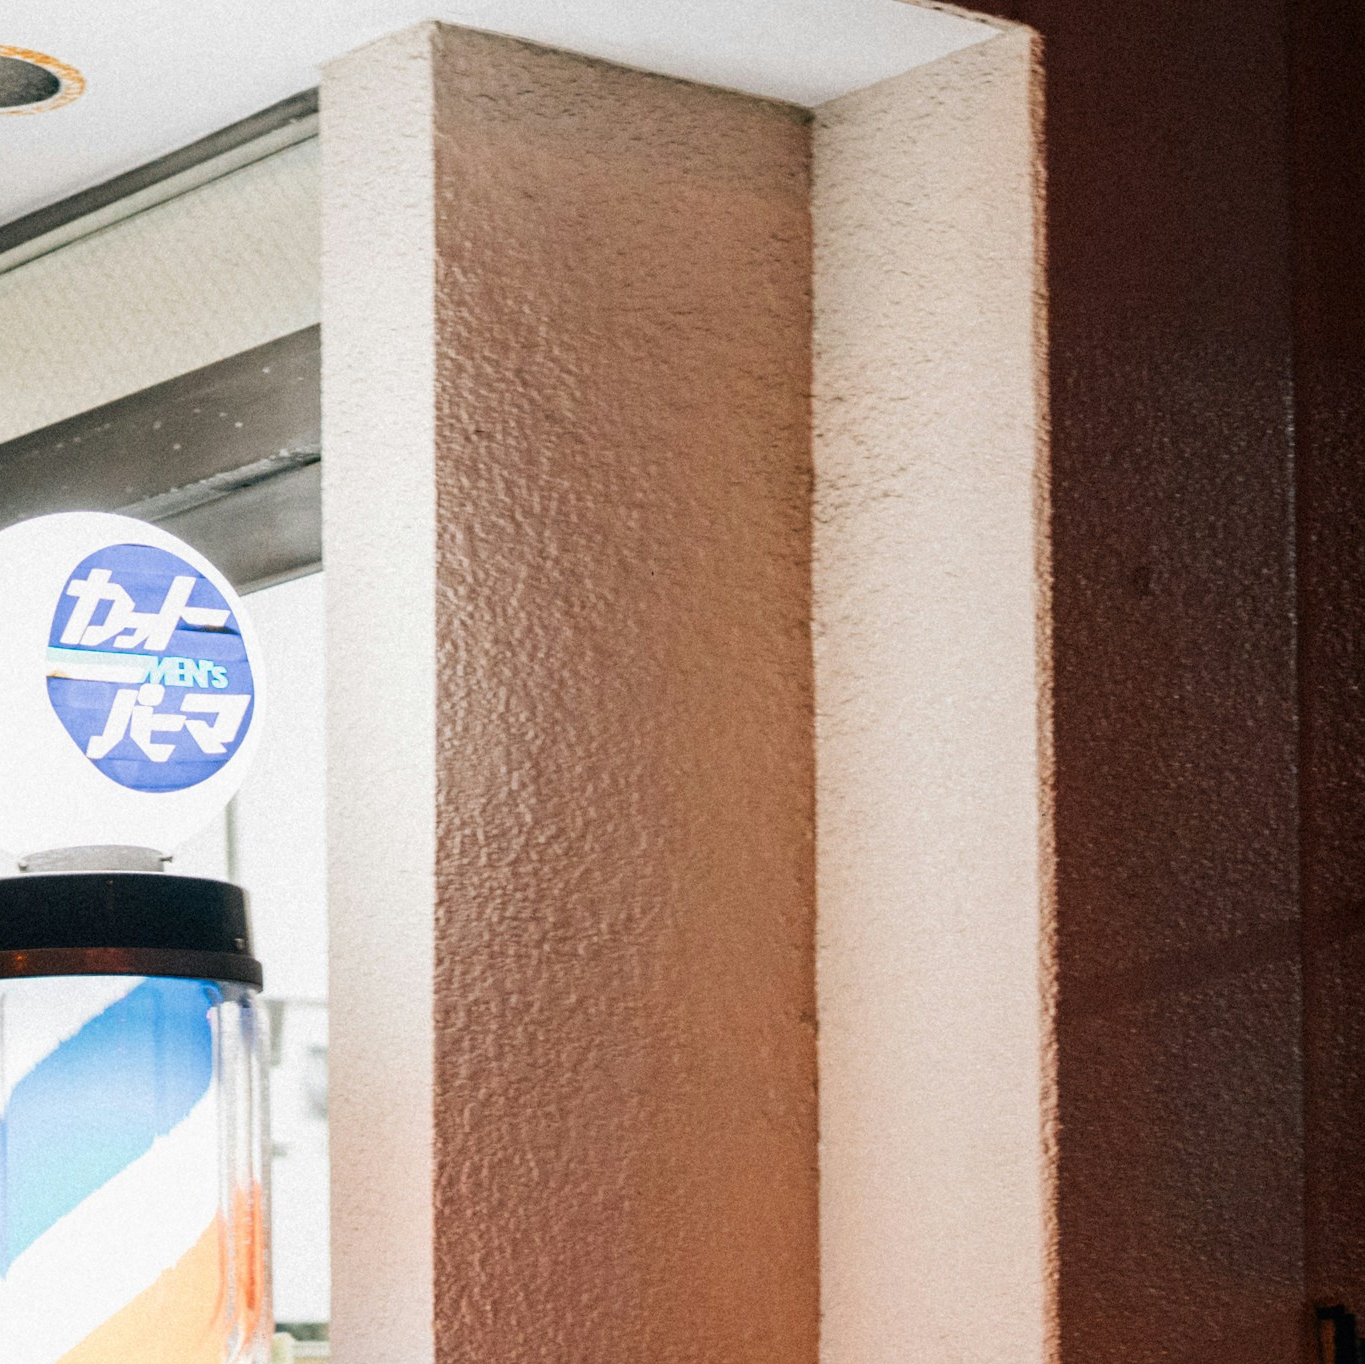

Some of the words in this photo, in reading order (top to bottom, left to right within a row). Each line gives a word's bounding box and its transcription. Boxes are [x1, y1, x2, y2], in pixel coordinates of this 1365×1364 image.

[60, 569, 232, 651] カット
[86, 683, 252, 763] パーマ
